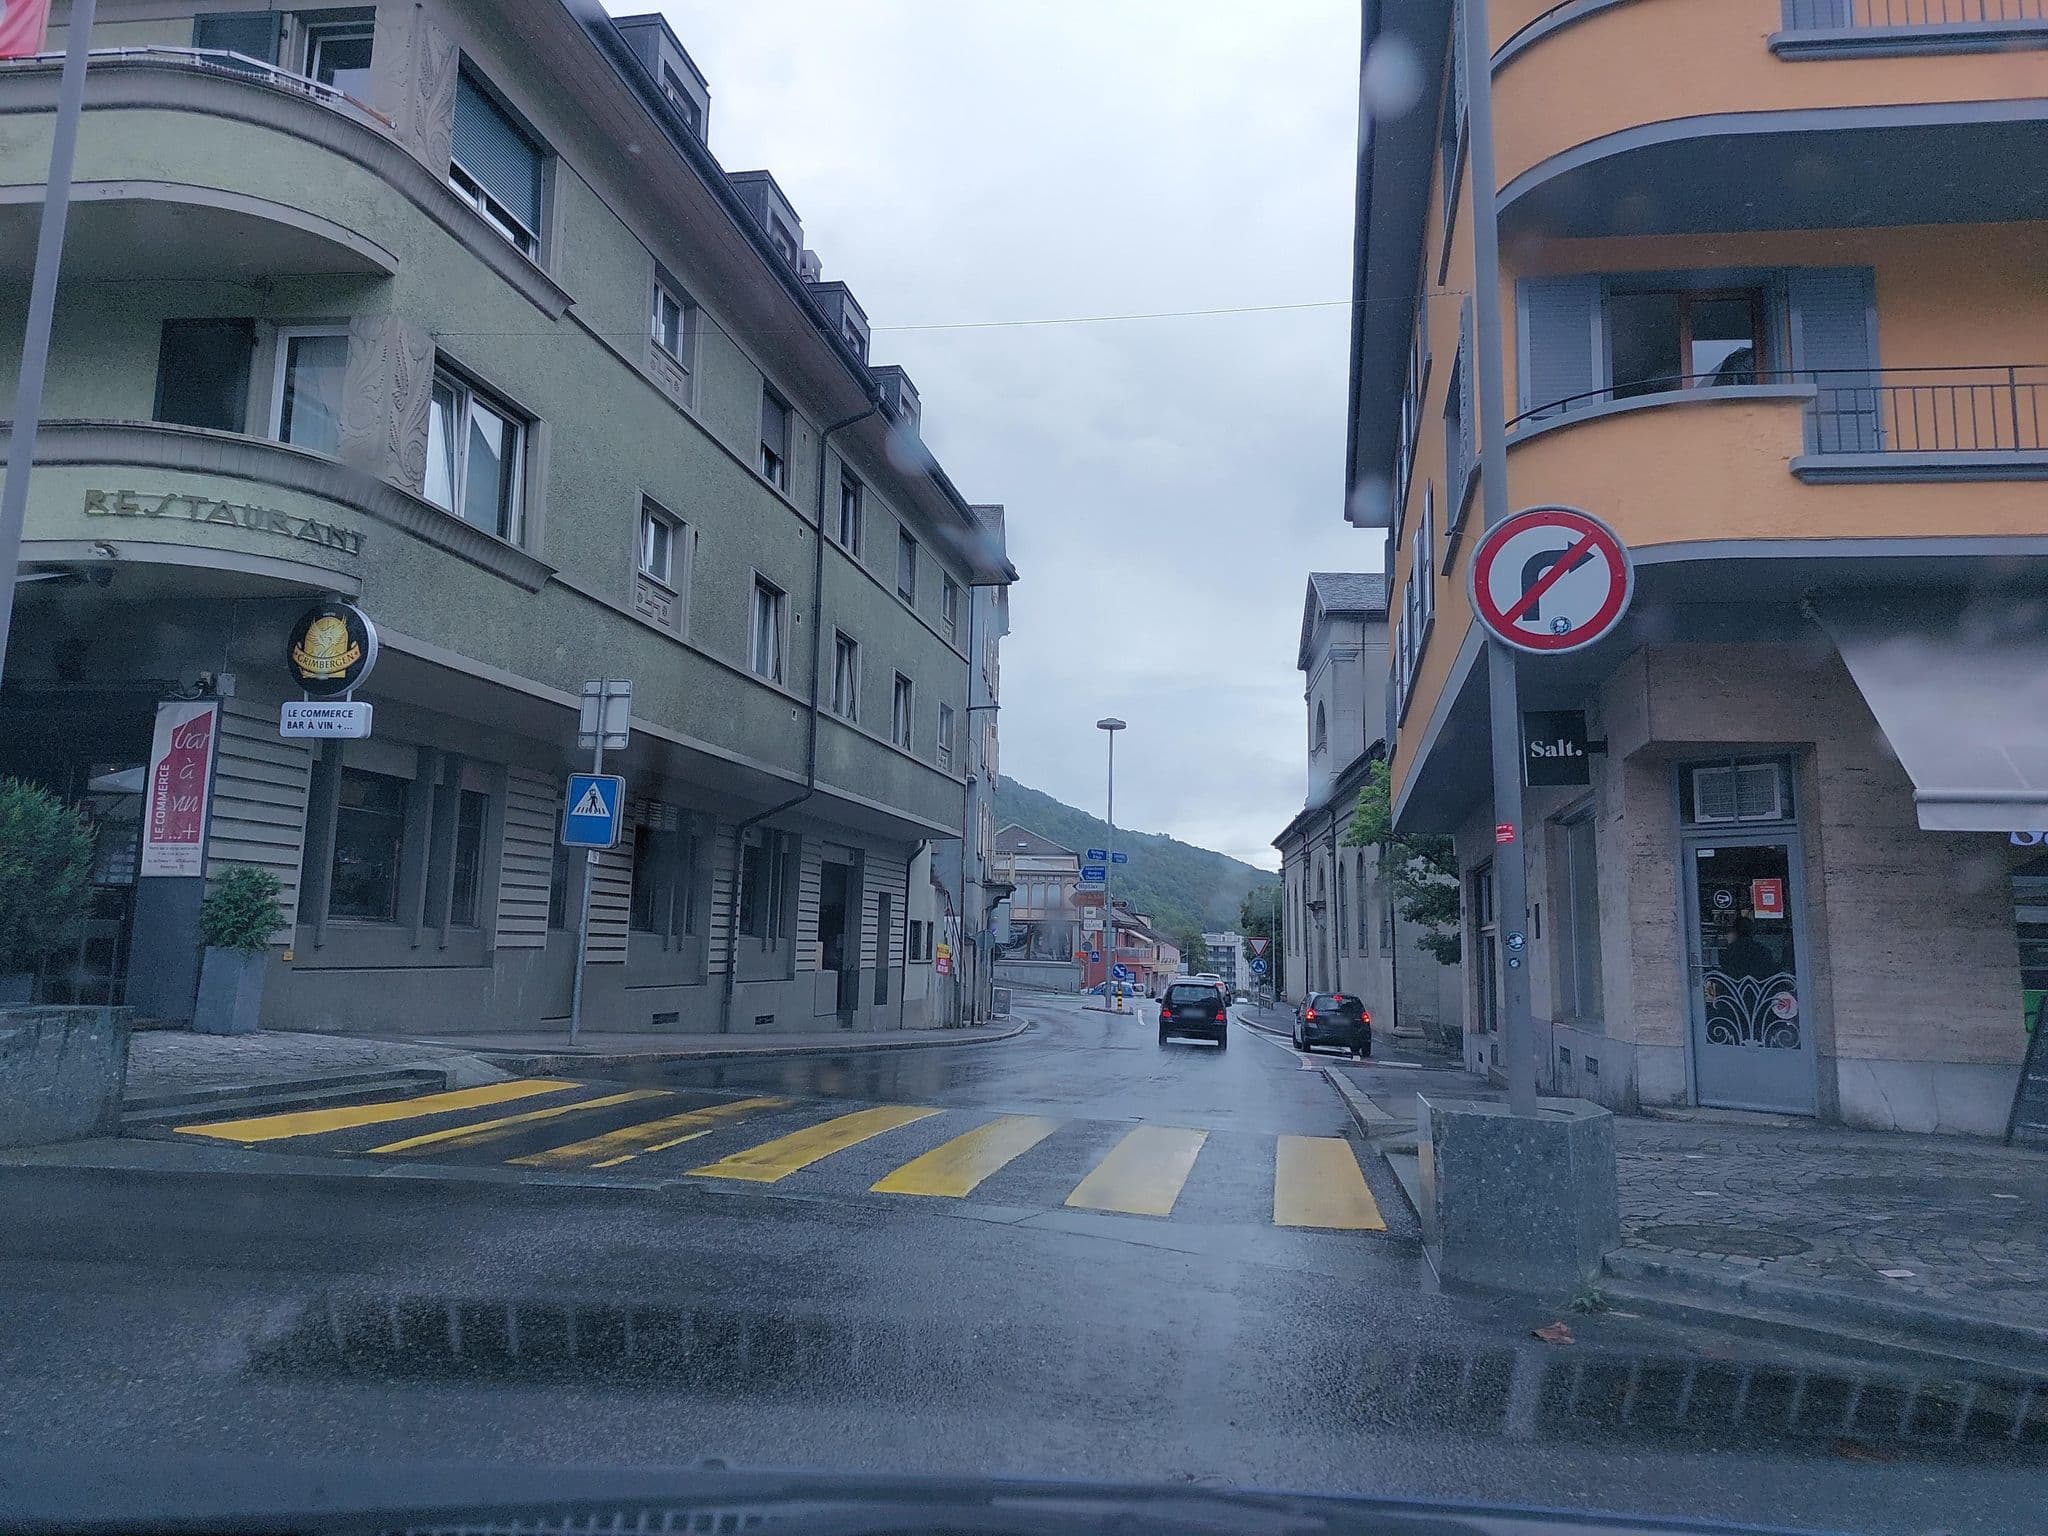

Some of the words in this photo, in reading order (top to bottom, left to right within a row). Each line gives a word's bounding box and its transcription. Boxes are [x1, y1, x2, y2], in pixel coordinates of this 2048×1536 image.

[84, 489, 367, 556] RESTAURANT
[297, 652, 355, 669] GRIMBERGEN
[287, 720, 305, 730] BAR
[307, 719, 315, 730] À
[317, 720, 333, 730] VIN
[288, 709, 298, 718] LE
[300, 709, 354, 719] COMMERCE
[174, 720, 211, 750] bar
[1530, 739, 1583, 758] Salt.
[179, 757, 196, 780] à
[155, 764, 170, 825] COMMERCE
[172, 784, 199, 813] vin
[154, 825, 165, 840] LE
